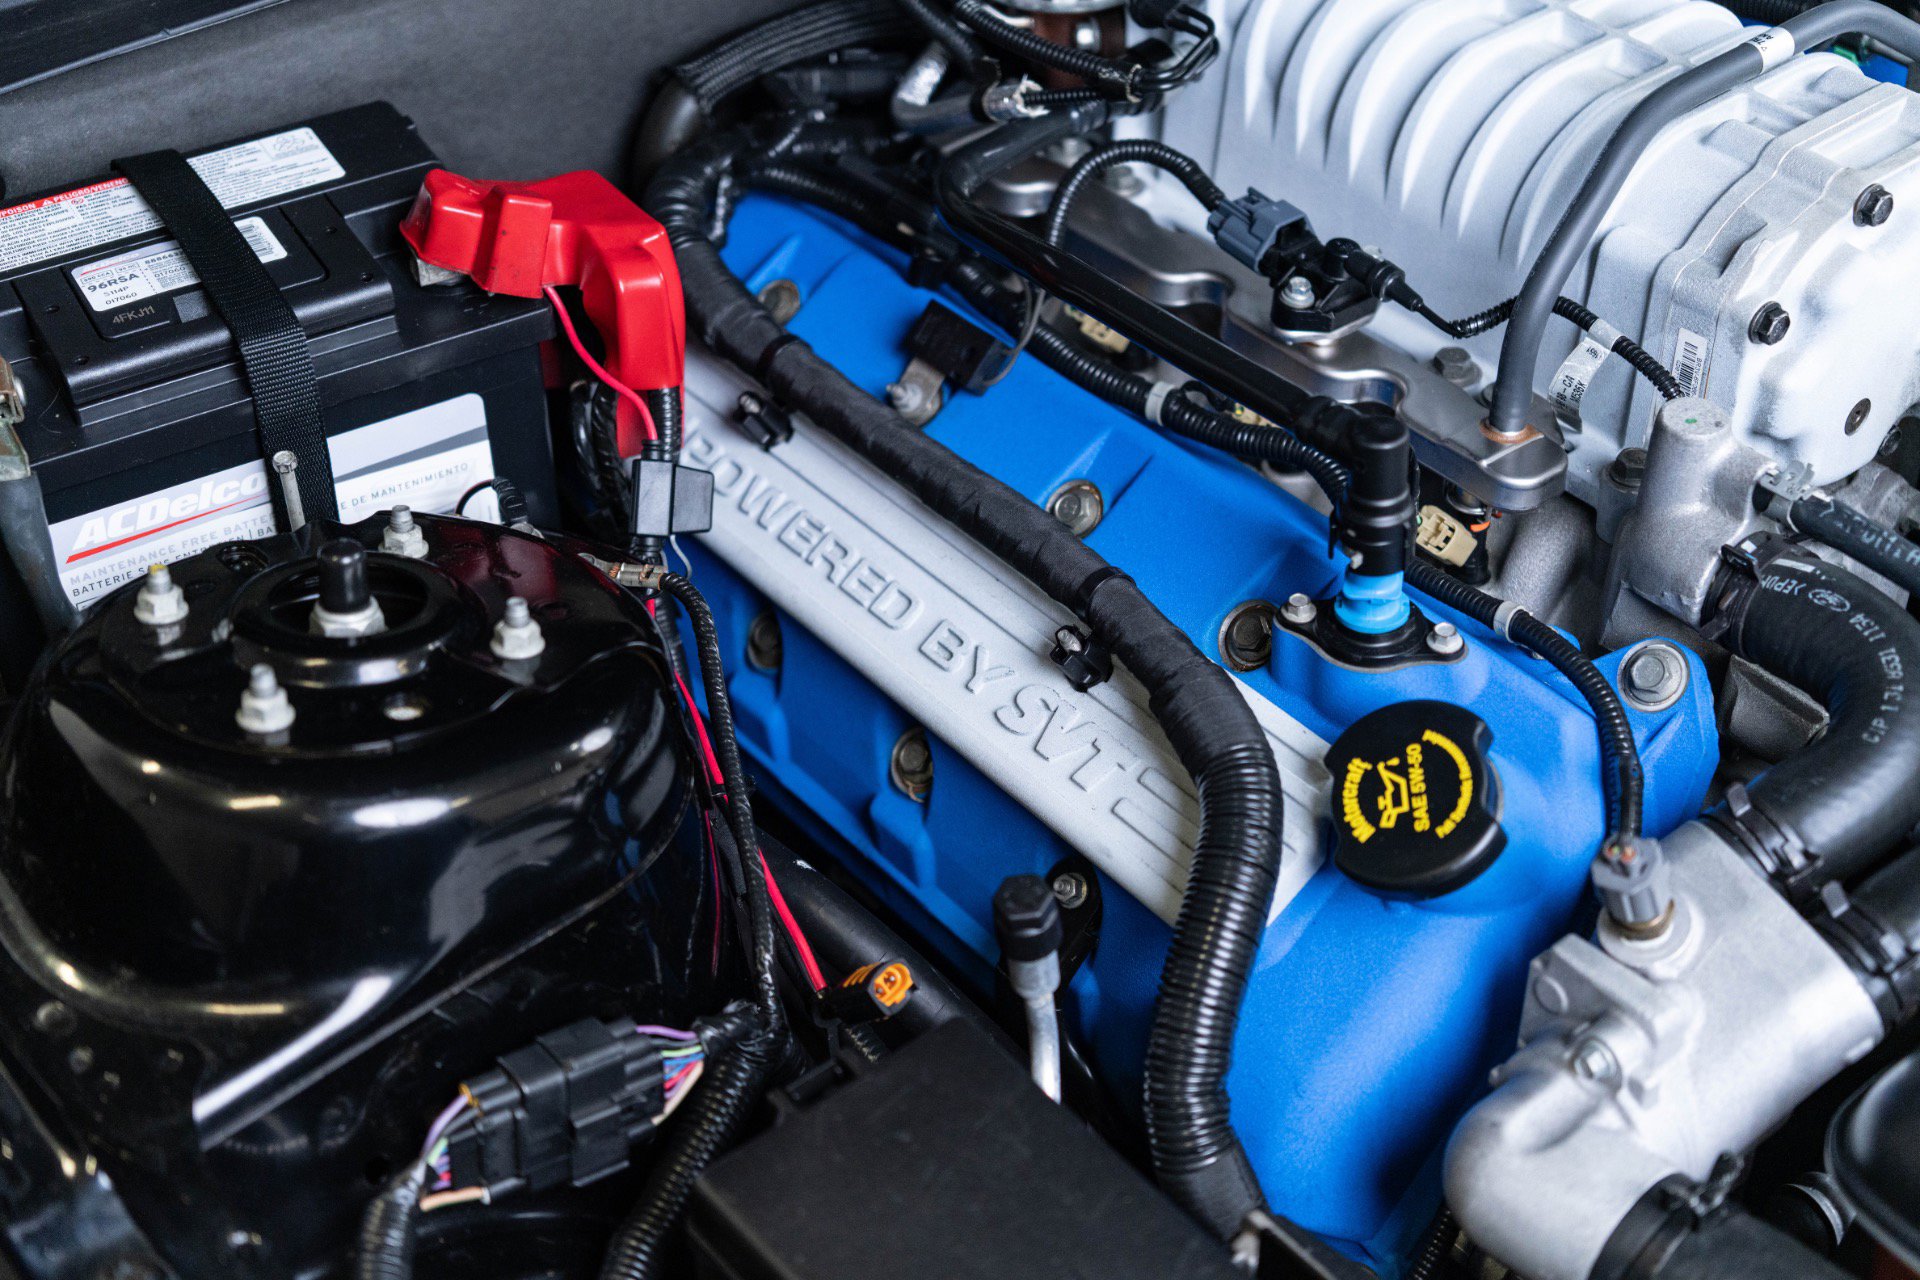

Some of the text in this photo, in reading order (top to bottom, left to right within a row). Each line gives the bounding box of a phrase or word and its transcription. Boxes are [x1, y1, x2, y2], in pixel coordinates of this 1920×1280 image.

[87, 272, 140, 292] 96RSA
[105, 292, 137, 305] 017060
[112, 305, 155, 323] 4FKJ11
[351, 495, 366, 507] DE
[371, 462, 469, 500] MANTENIMIENTO
[72, 471, 267, 551] ACDelco
[70, 544, 177, 586] MAINTENANCE
[181, 530, 218, 549] FREE
[73, 571, 133, 597] BATTERIE
[683, 428, 1140, 792] POWERED BY SVT
[1342, 757, 1376, 844] Motorcraft
[1406, 743, 1431, 833] SAE 5W-50
